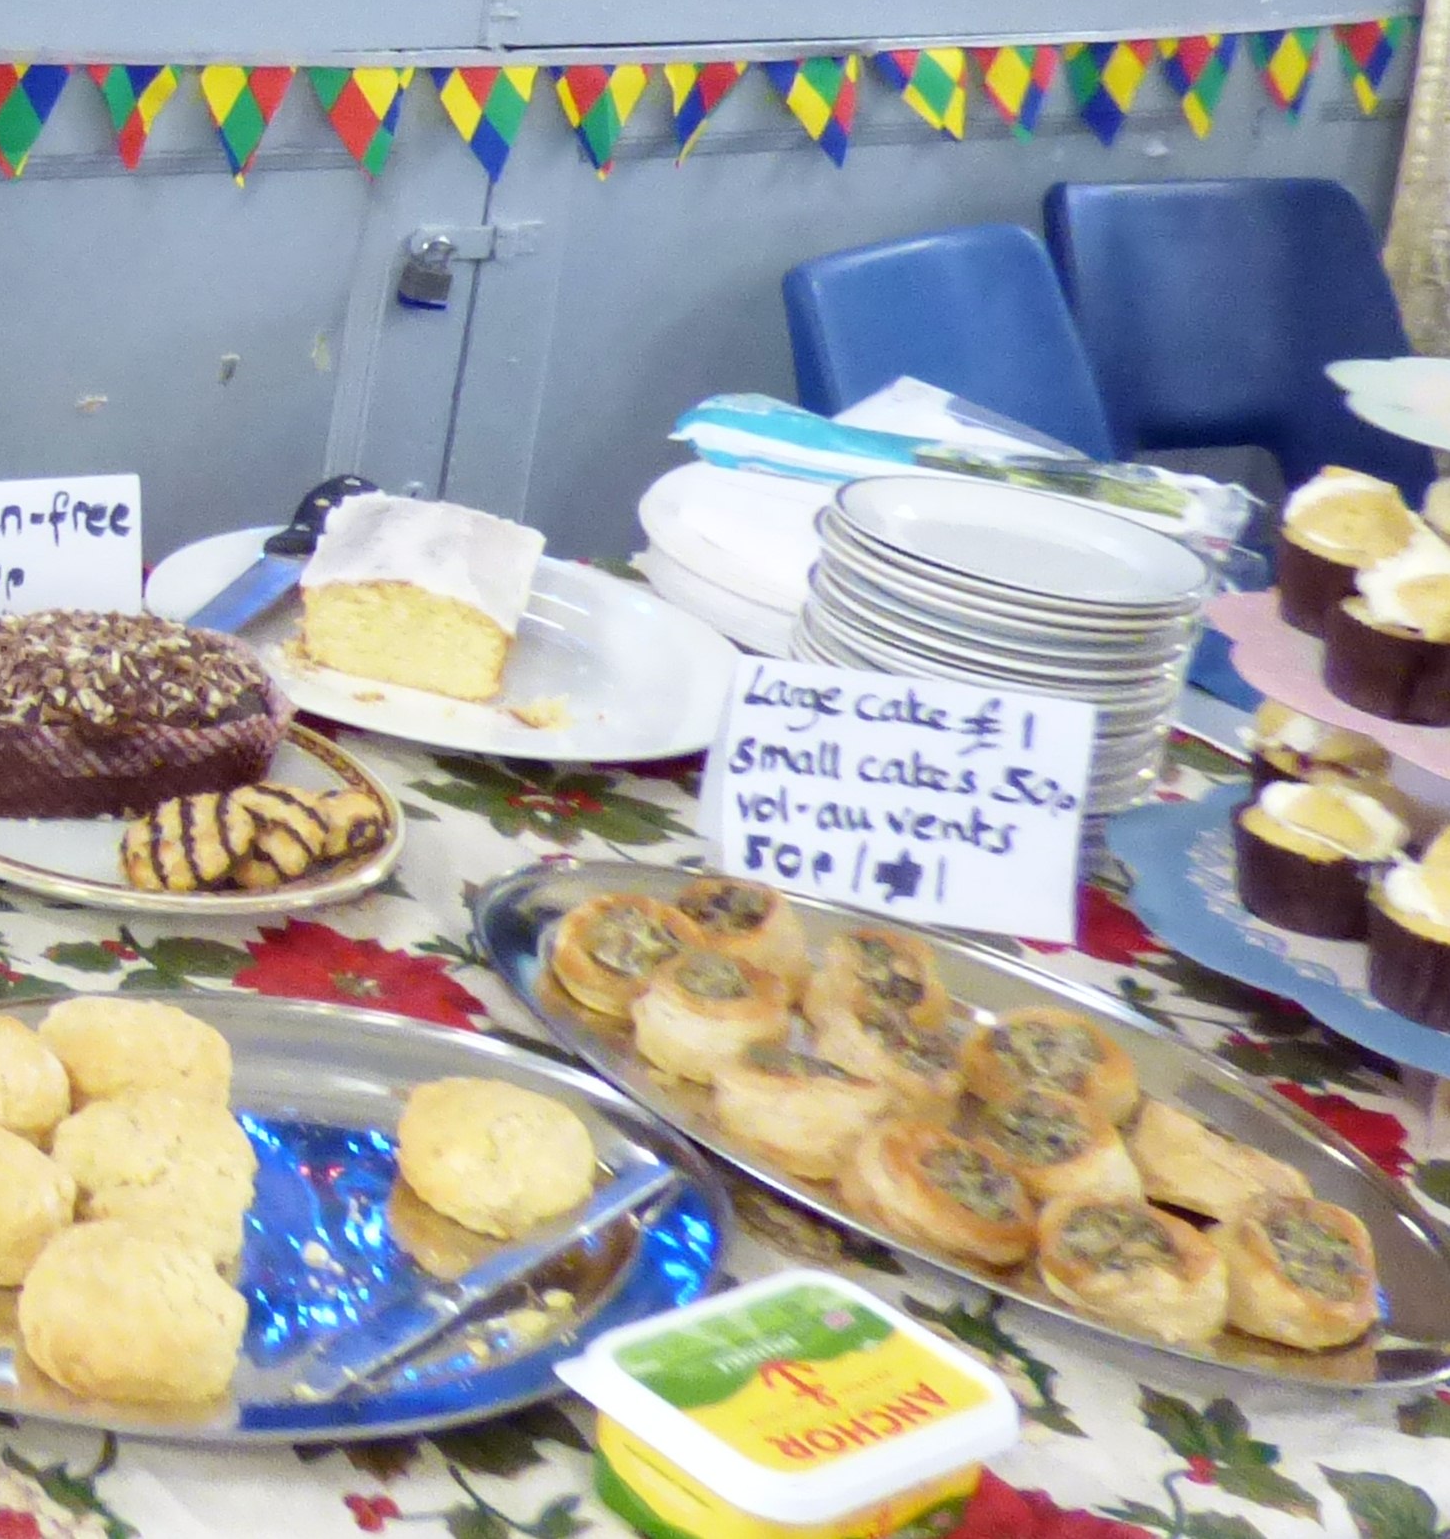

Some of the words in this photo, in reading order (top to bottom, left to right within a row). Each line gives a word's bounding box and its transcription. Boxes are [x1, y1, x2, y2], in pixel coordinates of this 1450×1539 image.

[743, 665, 843, 731] Large
[856, 750, 977, 794] cakes
[990, 767, 1077, 816] 50p
[765, 1381, 950, 1460] ANCHOR
